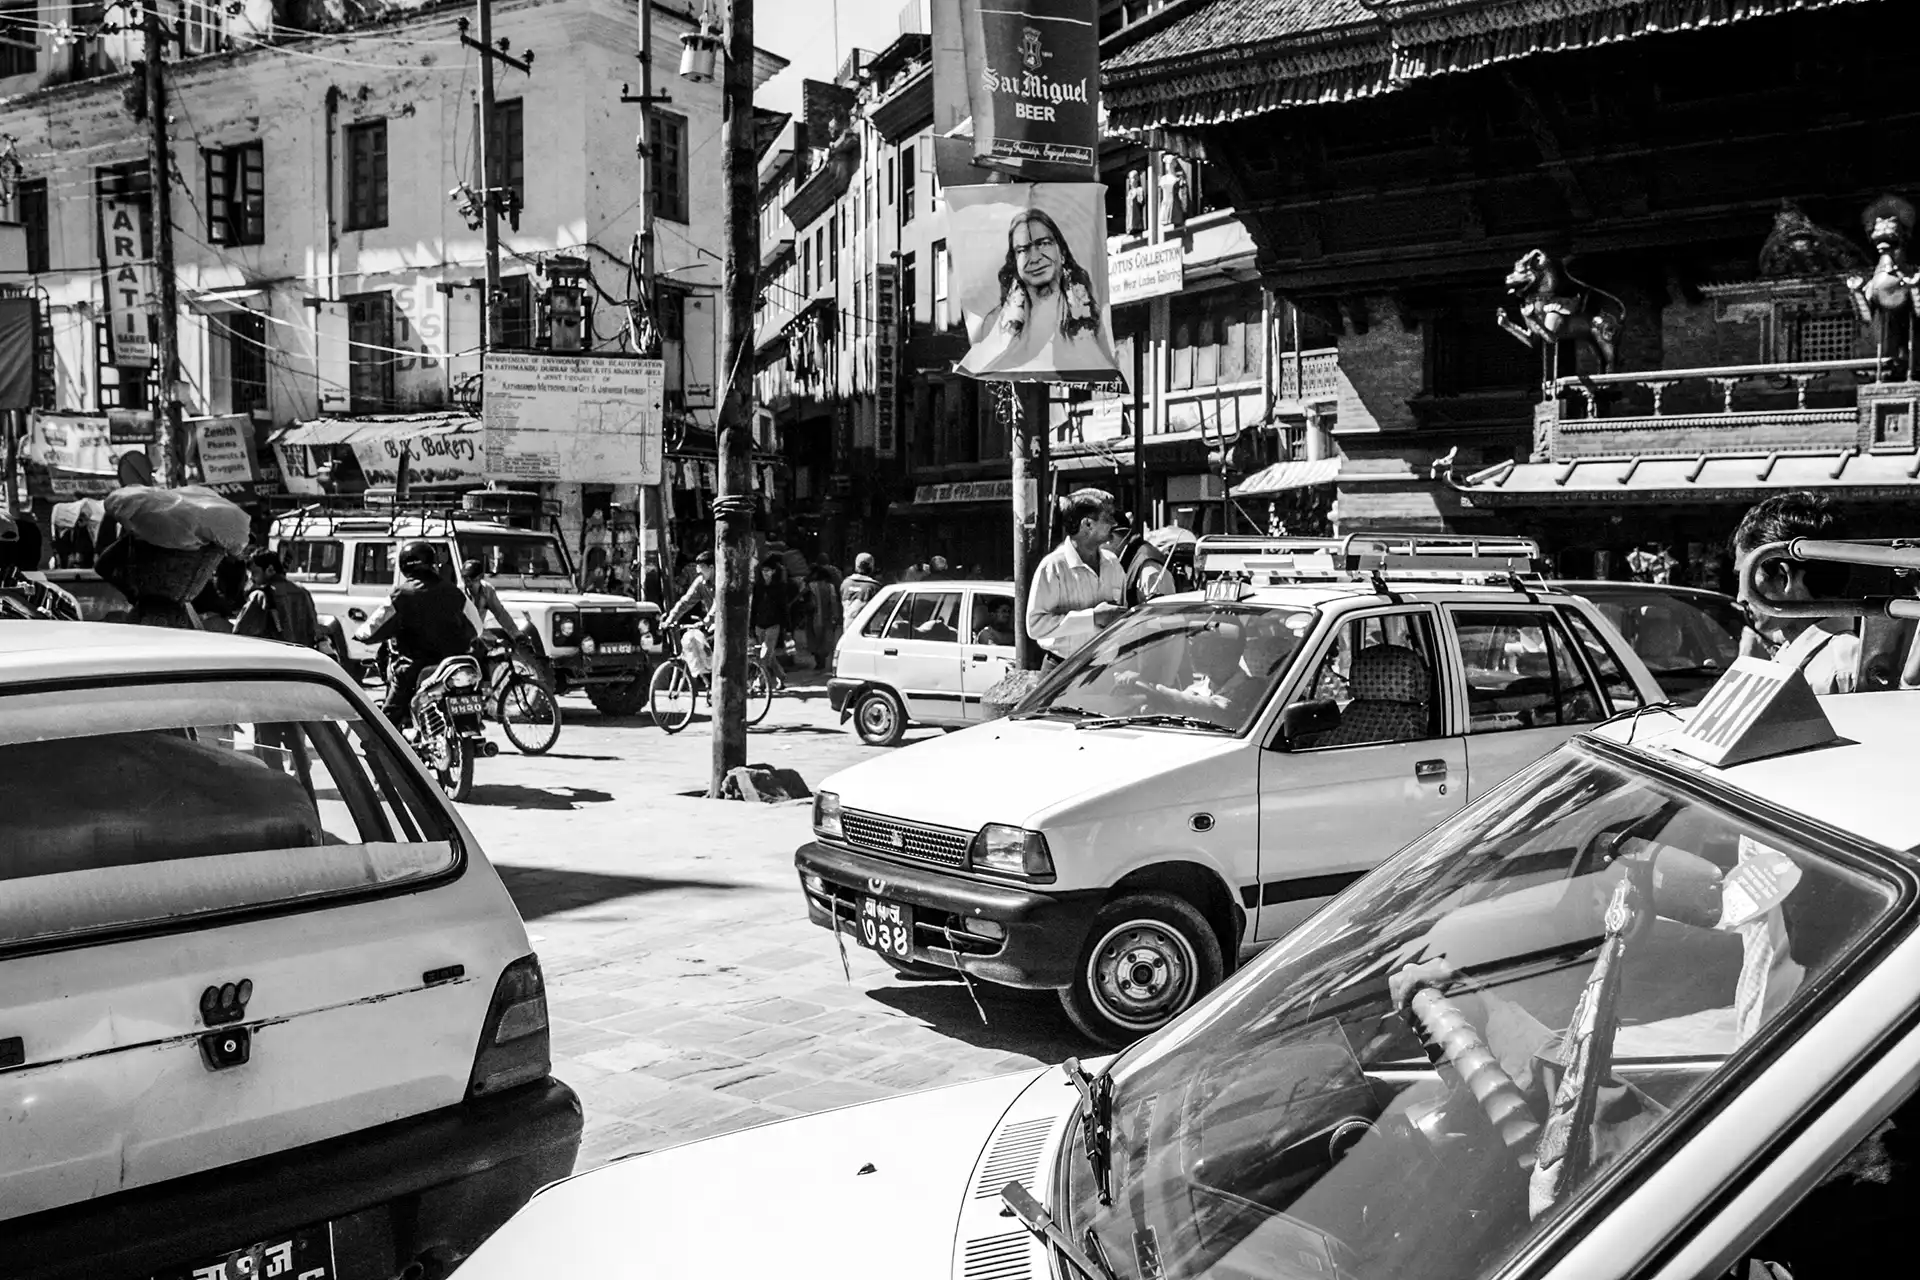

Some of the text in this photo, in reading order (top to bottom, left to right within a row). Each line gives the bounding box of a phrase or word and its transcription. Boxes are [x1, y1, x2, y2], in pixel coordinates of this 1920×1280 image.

[1021, 70, 1088, 104] Miguel
[1016, 102, 1055, 122] BEER
[1135, 247, 1181, 268] COLLECTION
[113, 210, 138, 333] ARATI
[495, 364, 538, 372] KATHMANDU
[542, 357, 590, 366] ENVIRONMENT
[608, 360, 663, 368] BEAUTIFICATION
[204, 425, 237, 438] Zenith
[207, 440, 237, 449] Pharma
[384, 438, 399, 459] B
[421, 433, 475, 461] Bakery
[1206, 581, 1239, 601] TAXI
[1682, 669, 1783, 749] TAXI
